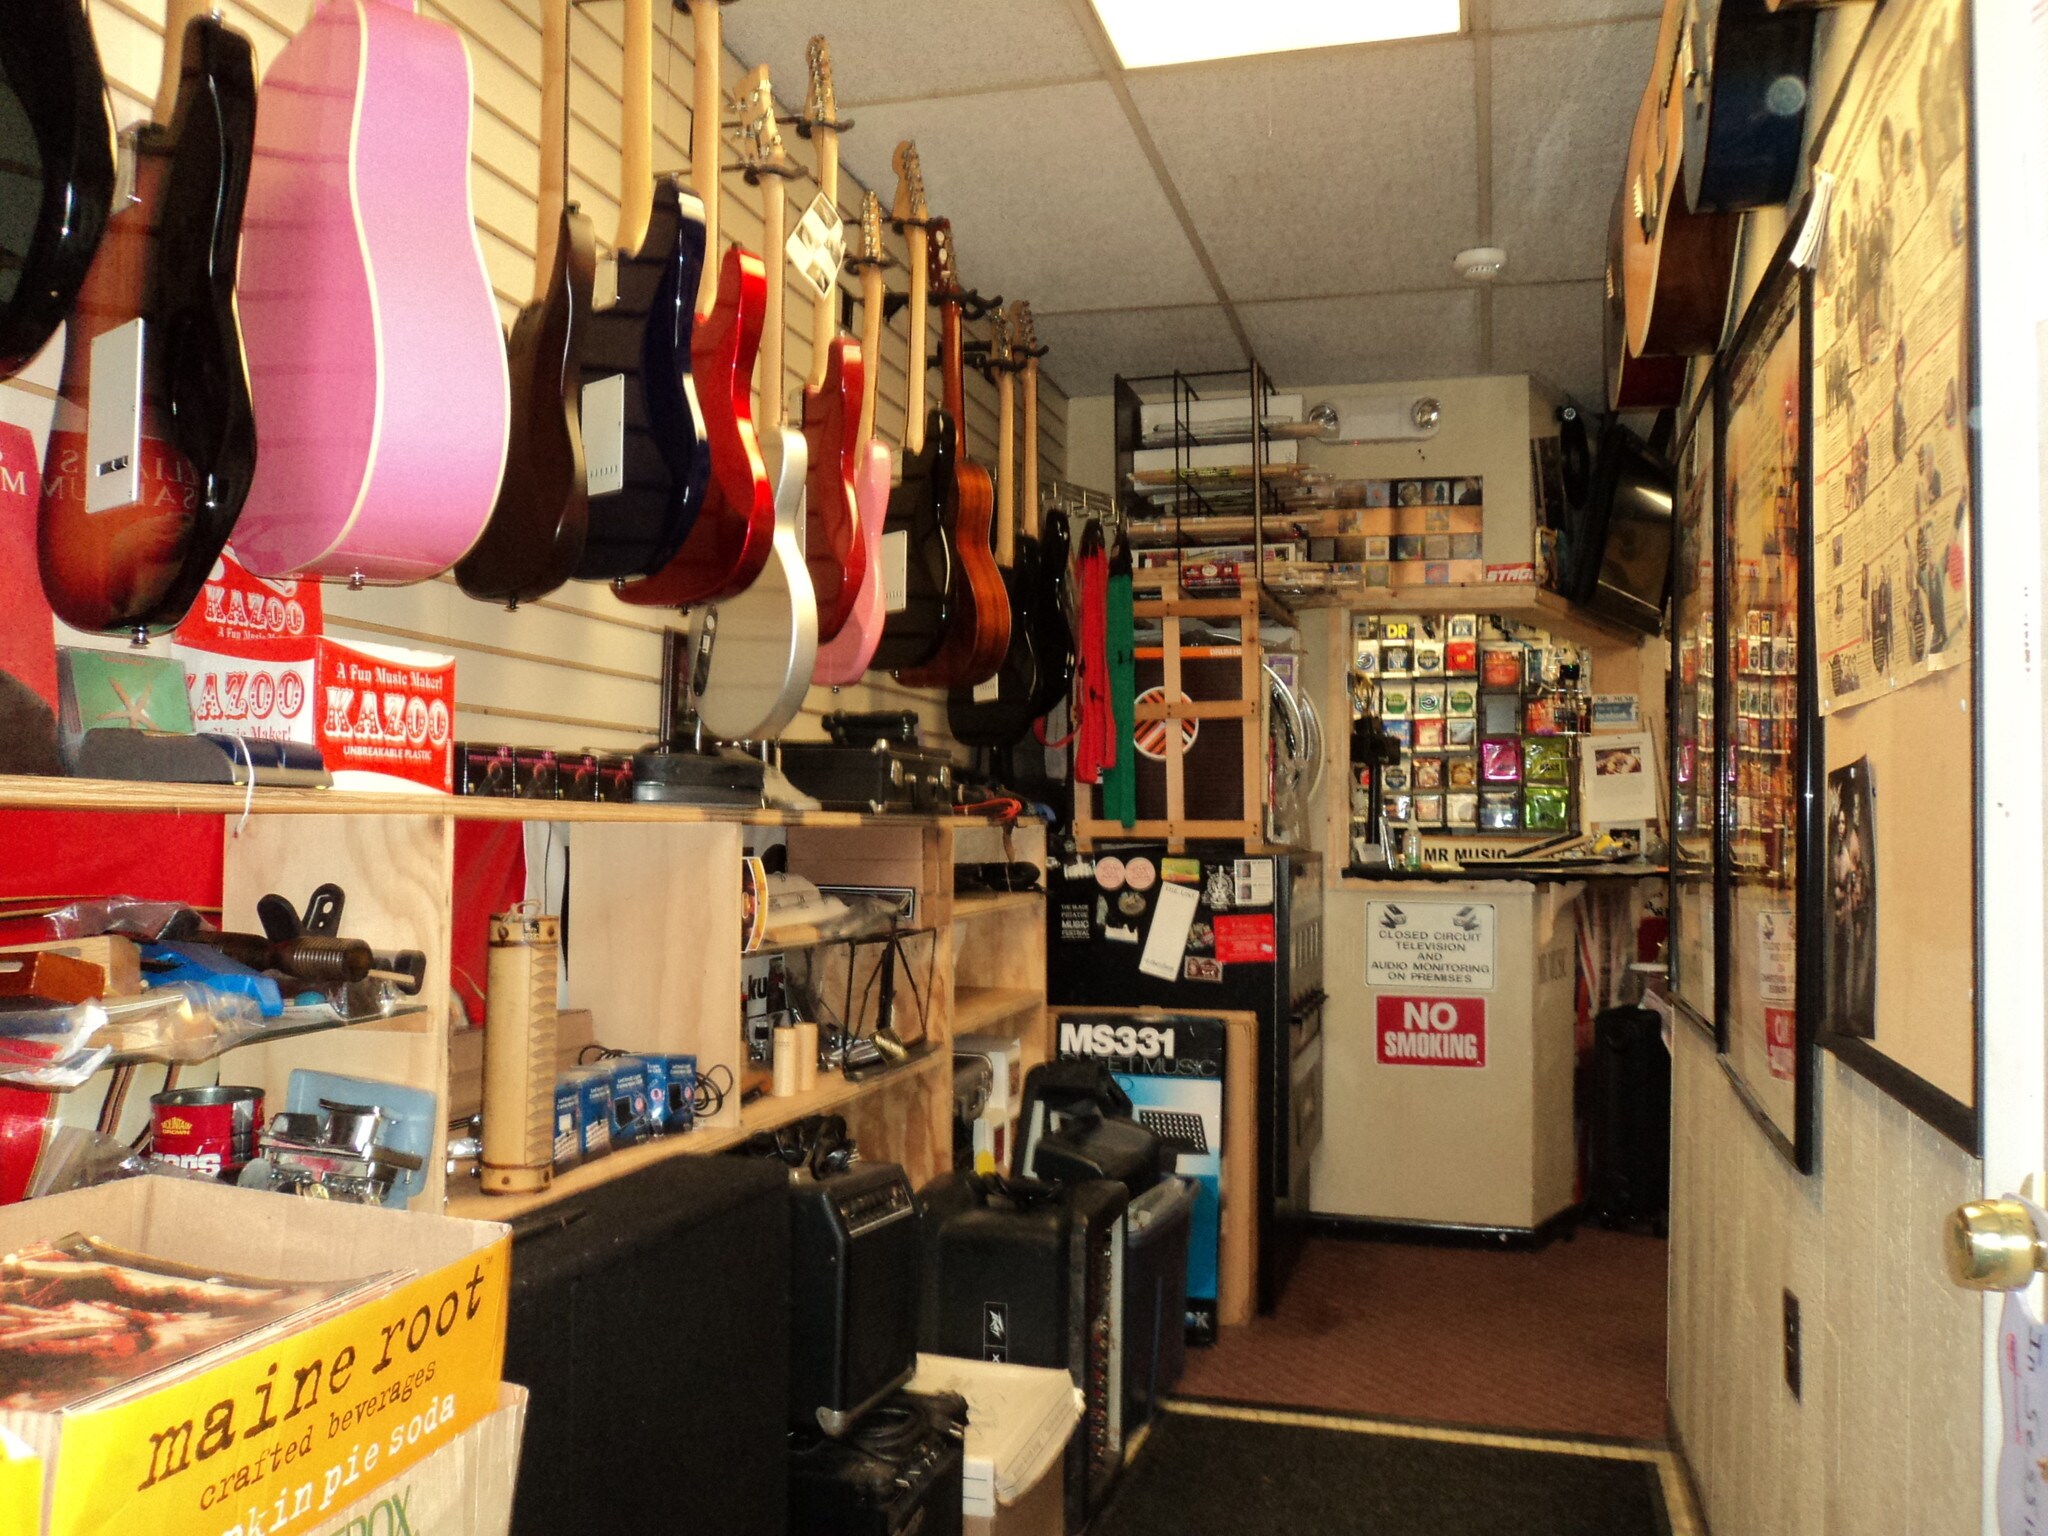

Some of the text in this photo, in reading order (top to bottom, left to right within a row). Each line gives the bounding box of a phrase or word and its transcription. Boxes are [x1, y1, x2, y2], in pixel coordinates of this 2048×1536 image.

[204, 584, 305, 635] KAZOO
[1387, 623, 1408, 638] DR
[337, 662, 443, 690] A Fun Music Maker!
[324, 686, 449, 745] KAZOO
[343, 746, 432, 760] UNBREAKABLE PLASTIC
[1424, 847, 1507, 863] MR MUSIC
[1061, 919, 1089, 929] MUSIC
[1378, 930, 1481, 942] CLOSED CIRCUIT
[1396, 941, 1466, 951] TELEVISION
[1417, 951, 1443, 961] AND
[1371, 961, 1490, 974] AUDIO MONITORING
[1387, 972, 1473, 983] ON PREMISES
[1403, 1001, 1458, 1031] NO
[1060, 1023, 1175, 1059] MS331
[1384, 1031, 1478, 1060] SMOKING
[138, 1263, 484, 1491] maine root
[200, 1359, 436, 1511] crafted beverages
[318, 1443, 379, 1512] pie
[387, 1393, 455, 1458] soda
